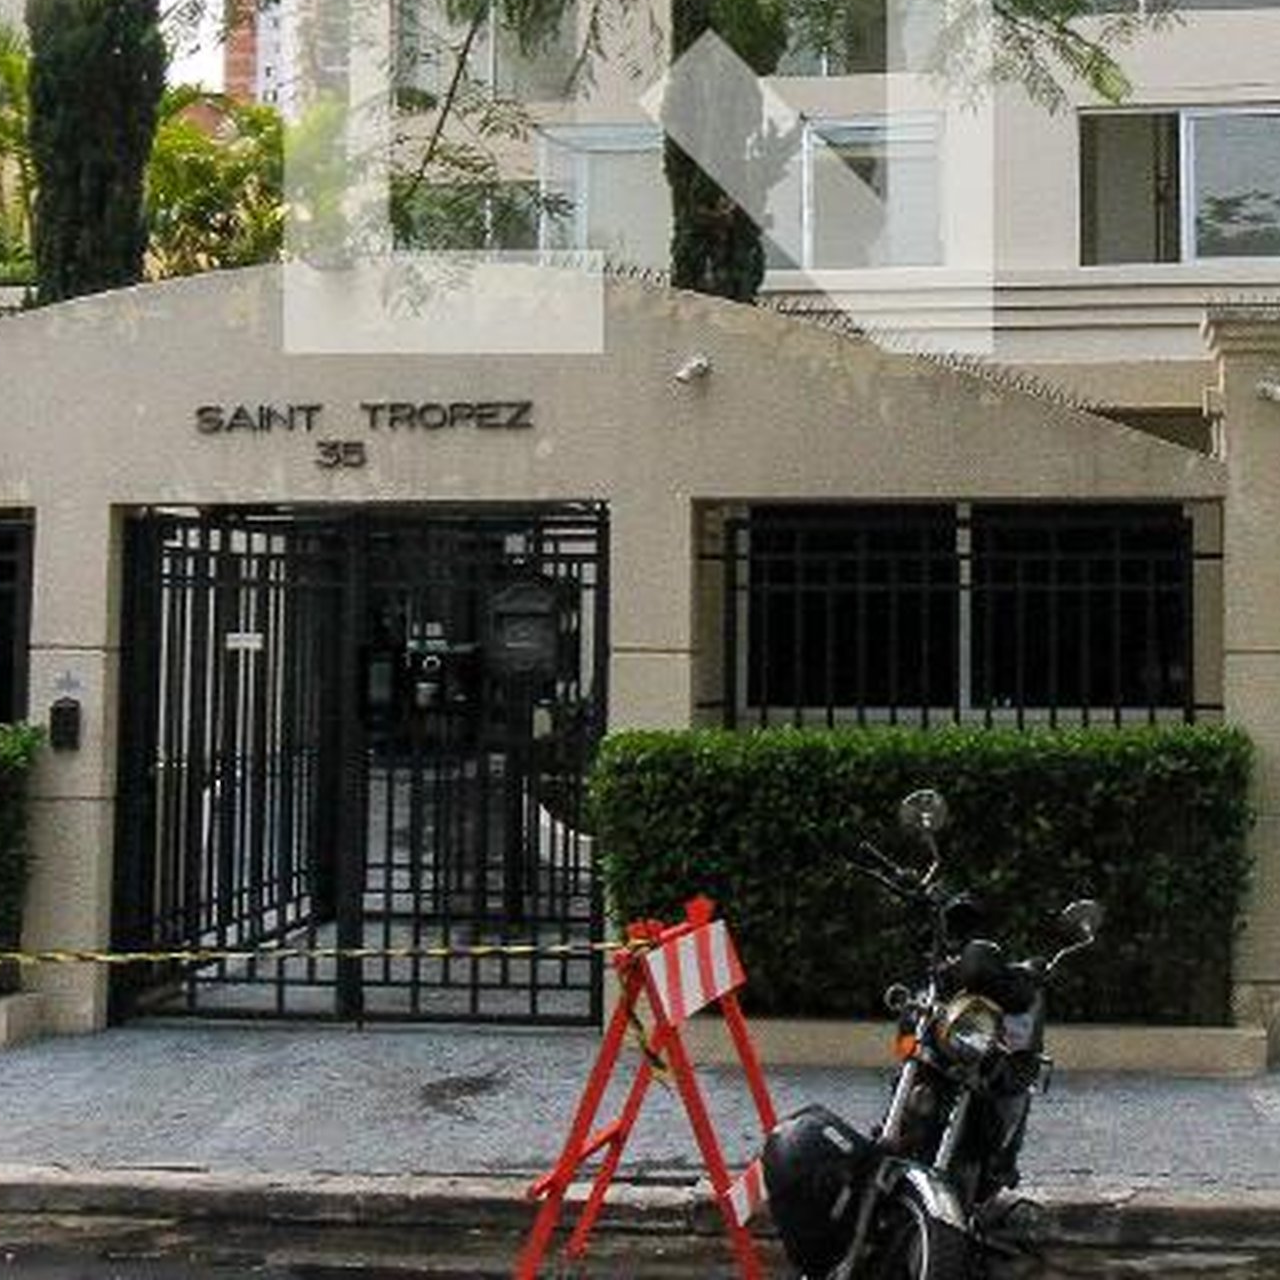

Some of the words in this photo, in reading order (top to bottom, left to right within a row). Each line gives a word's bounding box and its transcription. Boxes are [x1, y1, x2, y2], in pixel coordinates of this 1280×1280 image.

[195, 405, 322, 434] SAINT
[360, 401, 533, 430] TROPEZ
[316, 441, 366, 469] 35
